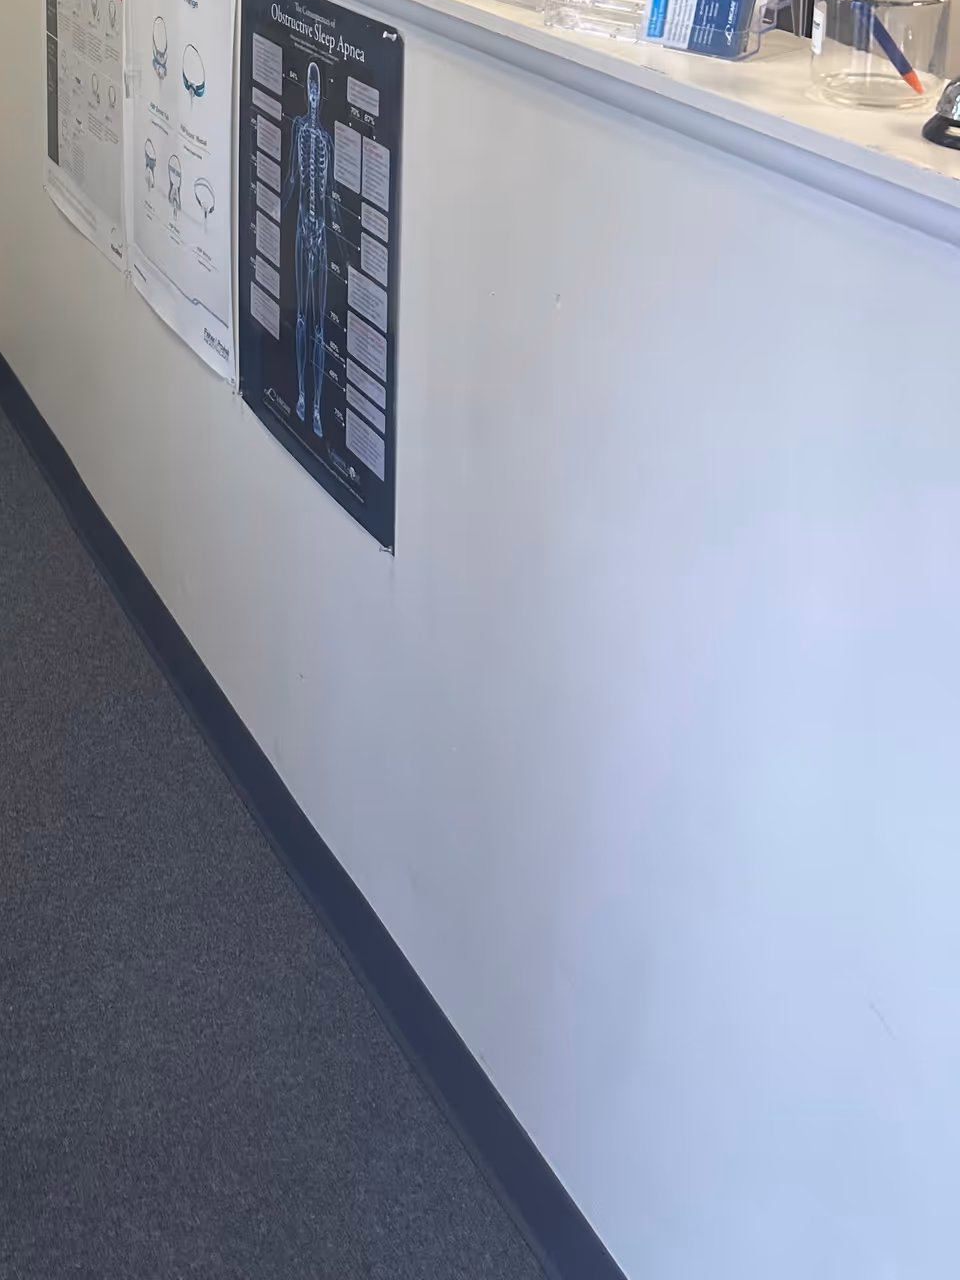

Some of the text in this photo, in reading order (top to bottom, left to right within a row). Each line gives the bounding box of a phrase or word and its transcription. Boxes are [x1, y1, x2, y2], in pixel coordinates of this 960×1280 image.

[271, 3, 365, 62] Obstructive Sleep Apnea
[728, 0, 736, 24] LINCARE
